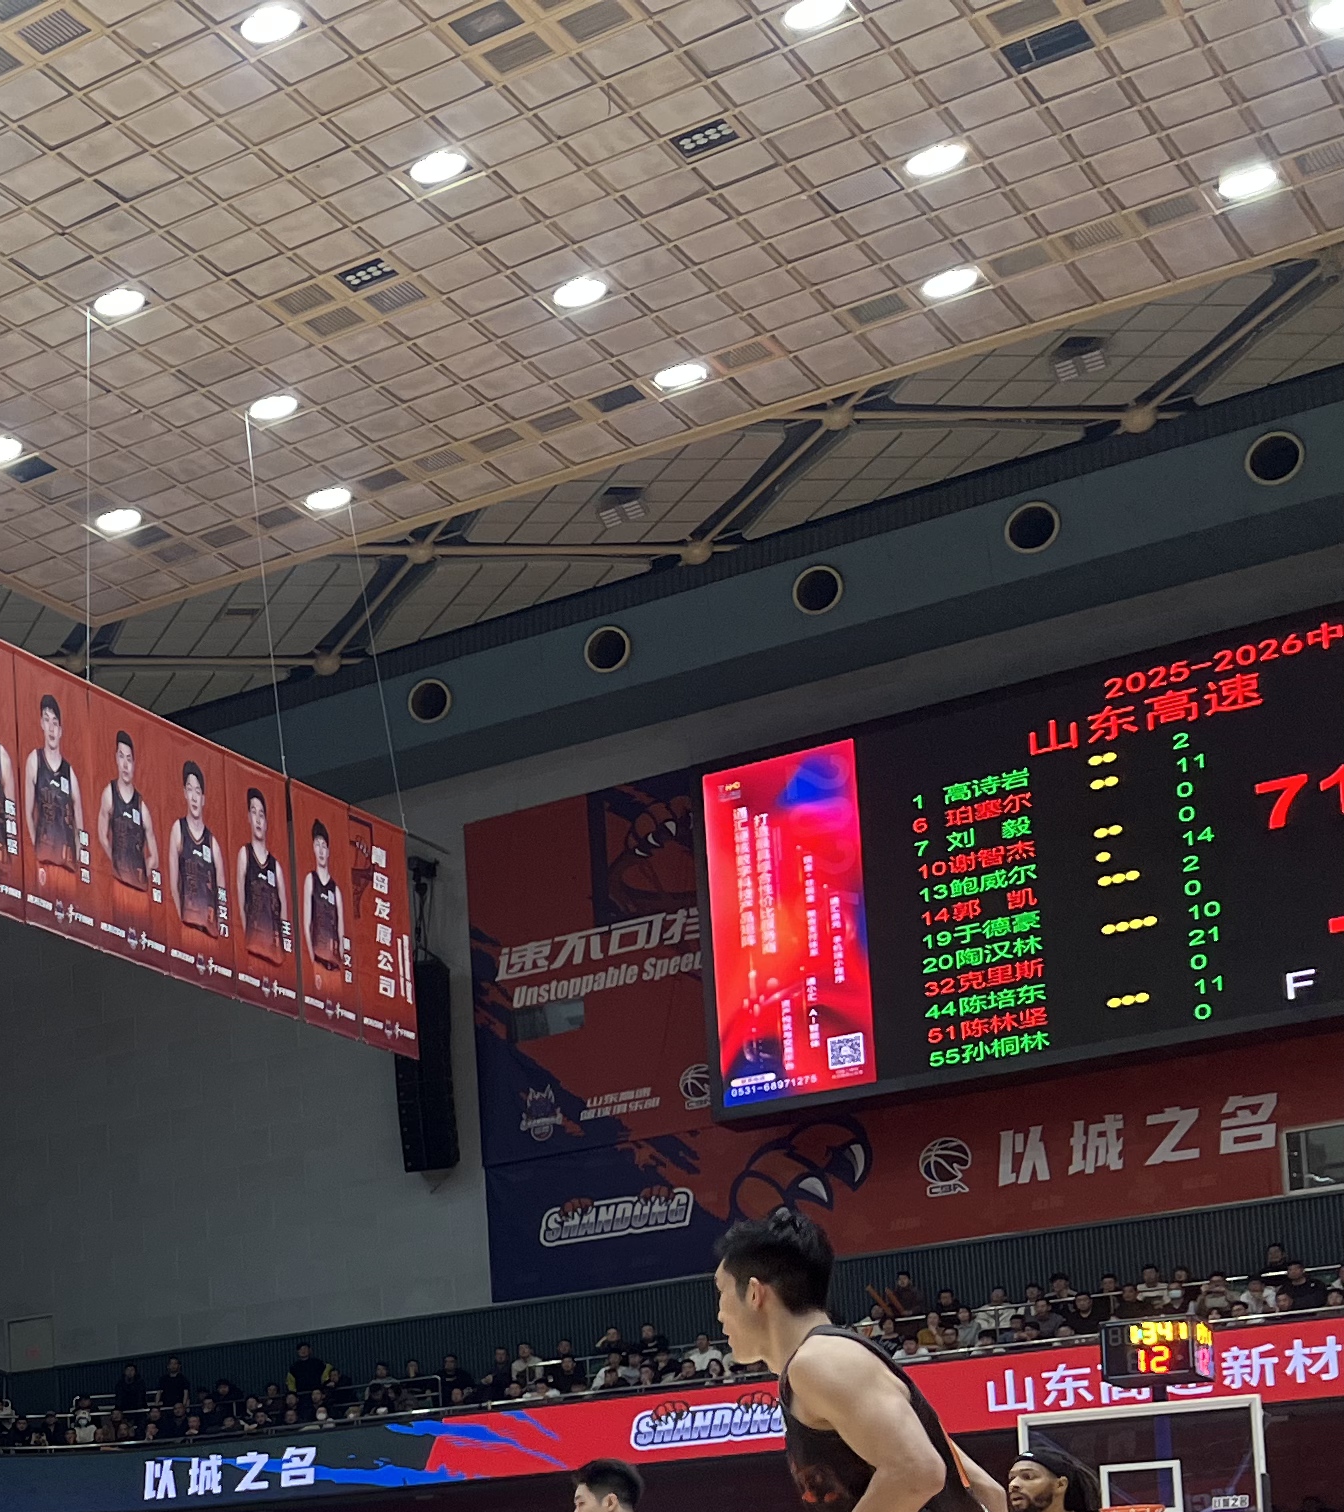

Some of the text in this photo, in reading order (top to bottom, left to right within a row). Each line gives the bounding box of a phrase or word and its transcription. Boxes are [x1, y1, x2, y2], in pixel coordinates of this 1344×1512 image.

[1027, 671, 1265, 756] 山东高速
[1172, 732, 1191, 751] 2
[1176, 753, 1207, 775] 11
[912, 767, 1031, 810] 1 高诗岩
[1176, 781, 1193, 799] 0
[912, 791, 1033, 834] 6 珀塞尔
[1178, 805, 1196, 823] 0
[1182, 825, 1216, 847] 14
[913, 840, 930, 857] 7
[1182, 855, 1200, 874] 2
[1184, 879, 1202, 897] 0
[1188, 900, 1222, 921] 10
[1188, 925, 1221, 947] 21
[1190, 953, 1208, 971] 0
[512, 951, 703, 1010] Unstoppable Spee
[1194, 975, 1224, 996] 11
[1193, 1002, 1212, 1020] 0
[998, 1091, 1279, 1188] 以城之名
[543, 1191, 693, 1245] SHANDONG
[1137, 1345, 1172, 1374] 12
[142, 1444, 318, 1502] 以城之名
